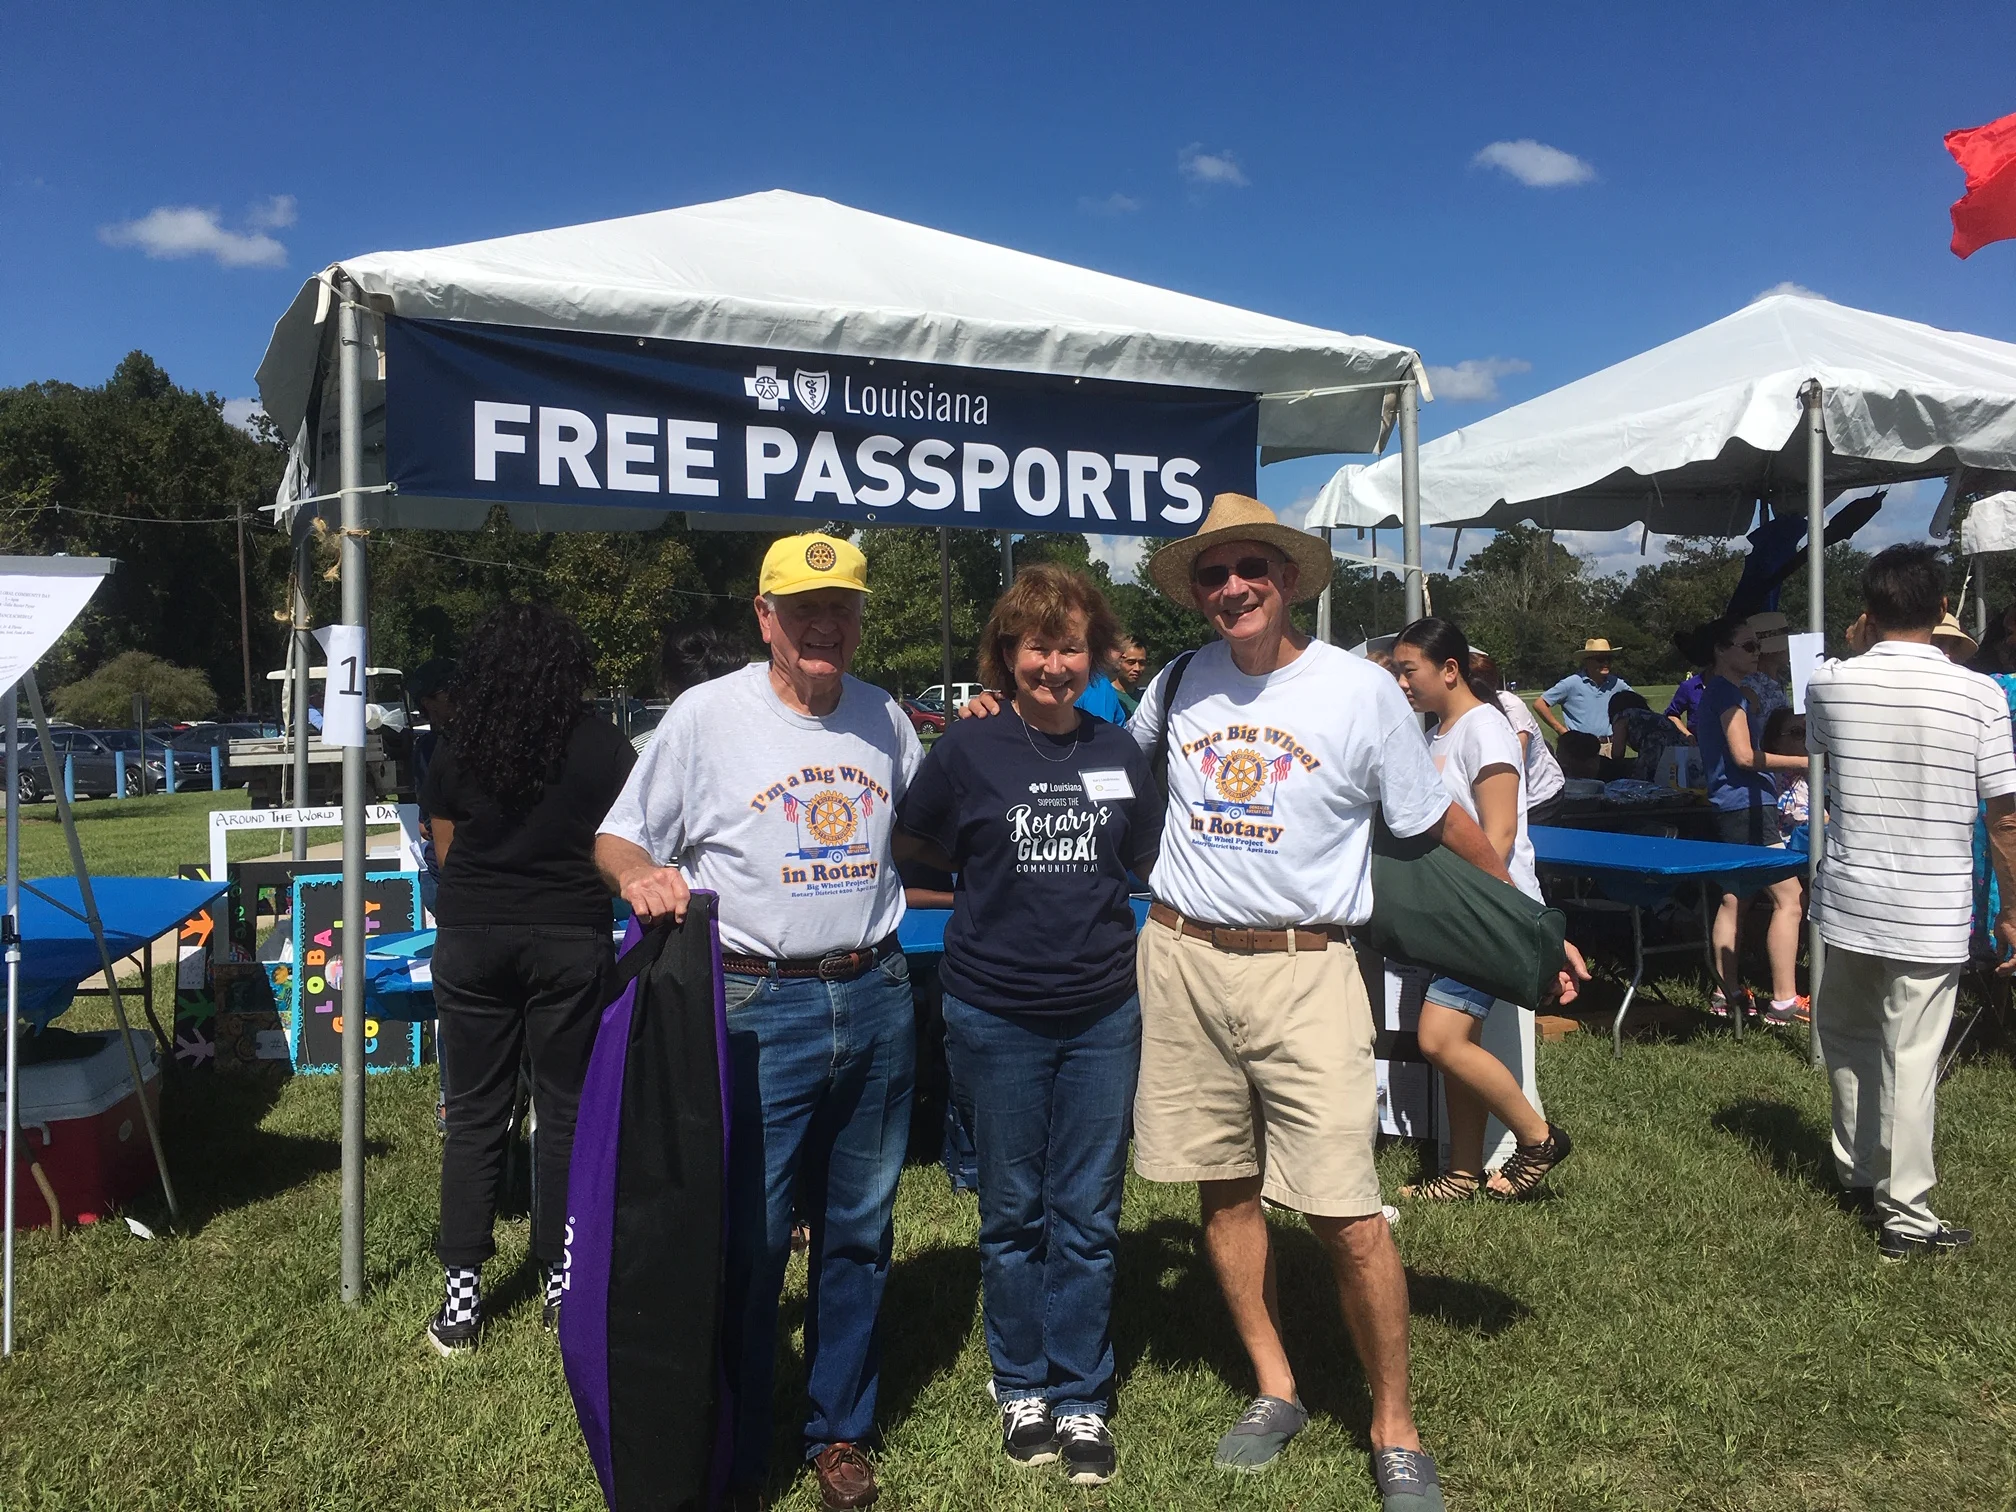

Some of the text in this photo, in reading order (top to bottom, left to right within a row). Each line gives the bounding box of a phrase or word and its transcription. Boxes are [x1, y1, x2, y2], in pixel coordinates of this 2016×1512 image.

[845, 375, 988, 425] Louisiana
[474, 400, 1204, 525] FREE PASSPORTS
[339, 656, 362, 695] 1
[1212, 732, 1222, 742] a
[1226, 725, 1258, 743] Big
[1264, 727, 1320, 772] Wheel
[751, 765, 890, 812] I'm a Big Wheel
[1050, 782, 1082, 792] Louisiana
[1037, 797, 1079, 807] SUPPORTS THE
[215, 812, 265, 827] AROUND
[268, 811, 293, 823] THE
[297, 809, 335, 823] WORLD
[376, 806, 400, 819] DAY
[1006, 804, 1112, 842] Rotary's
[1190, 813, 1284, 843] in Rotary
[1018, 836, 1098, 861] GLOBAL
[1214, 836, 1234, 844] Wheel
[1235, 838, 1263, 847] Project
[782, 862, 879, 884] in Rotary
[1016, 864, 1077, 873] COMMUNITY
[821, 881, 844, 889] Wheel
[845, 879, 869, 887] Project
